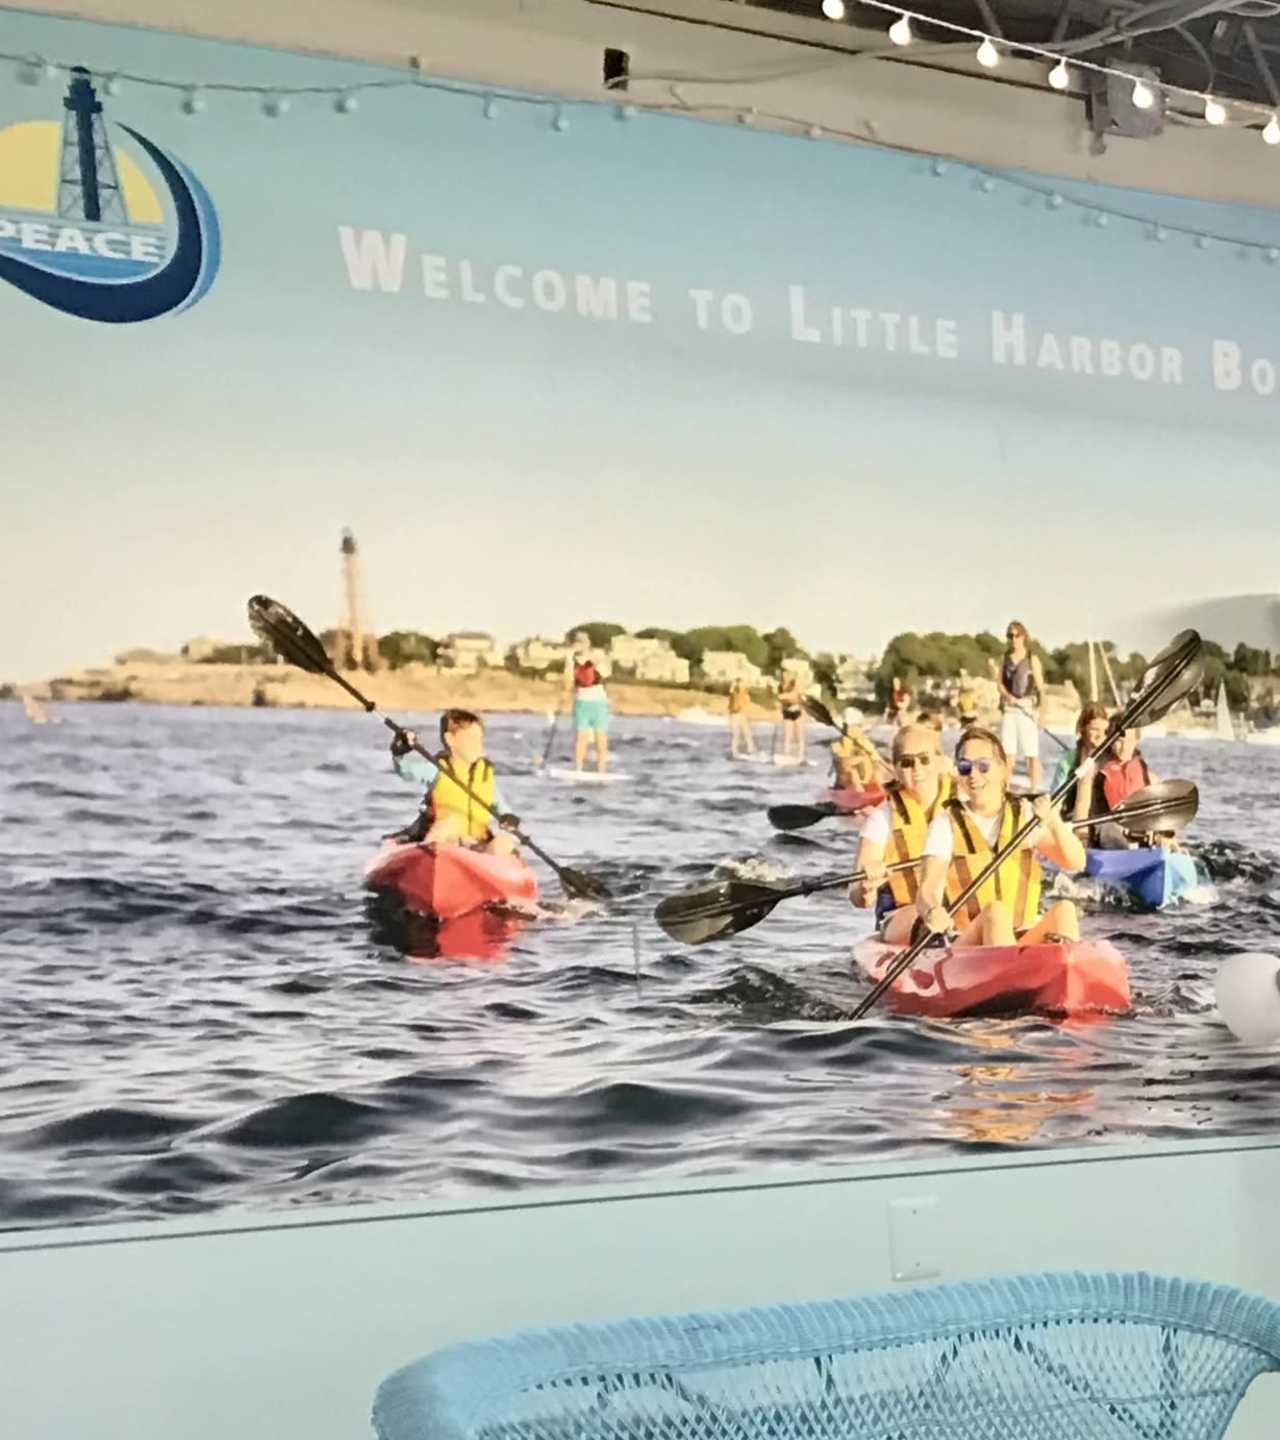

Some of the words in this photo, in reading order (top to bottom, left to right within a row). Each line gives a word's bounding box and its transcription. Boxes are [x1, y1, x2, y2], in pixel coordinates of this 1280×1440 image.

[338, 225, 653, 322] WELCOME
[688, 287, 753, 335] TO
[788, 284, 958, 359] LITTLE
[991, 310, 1184, 385] HARBOR
